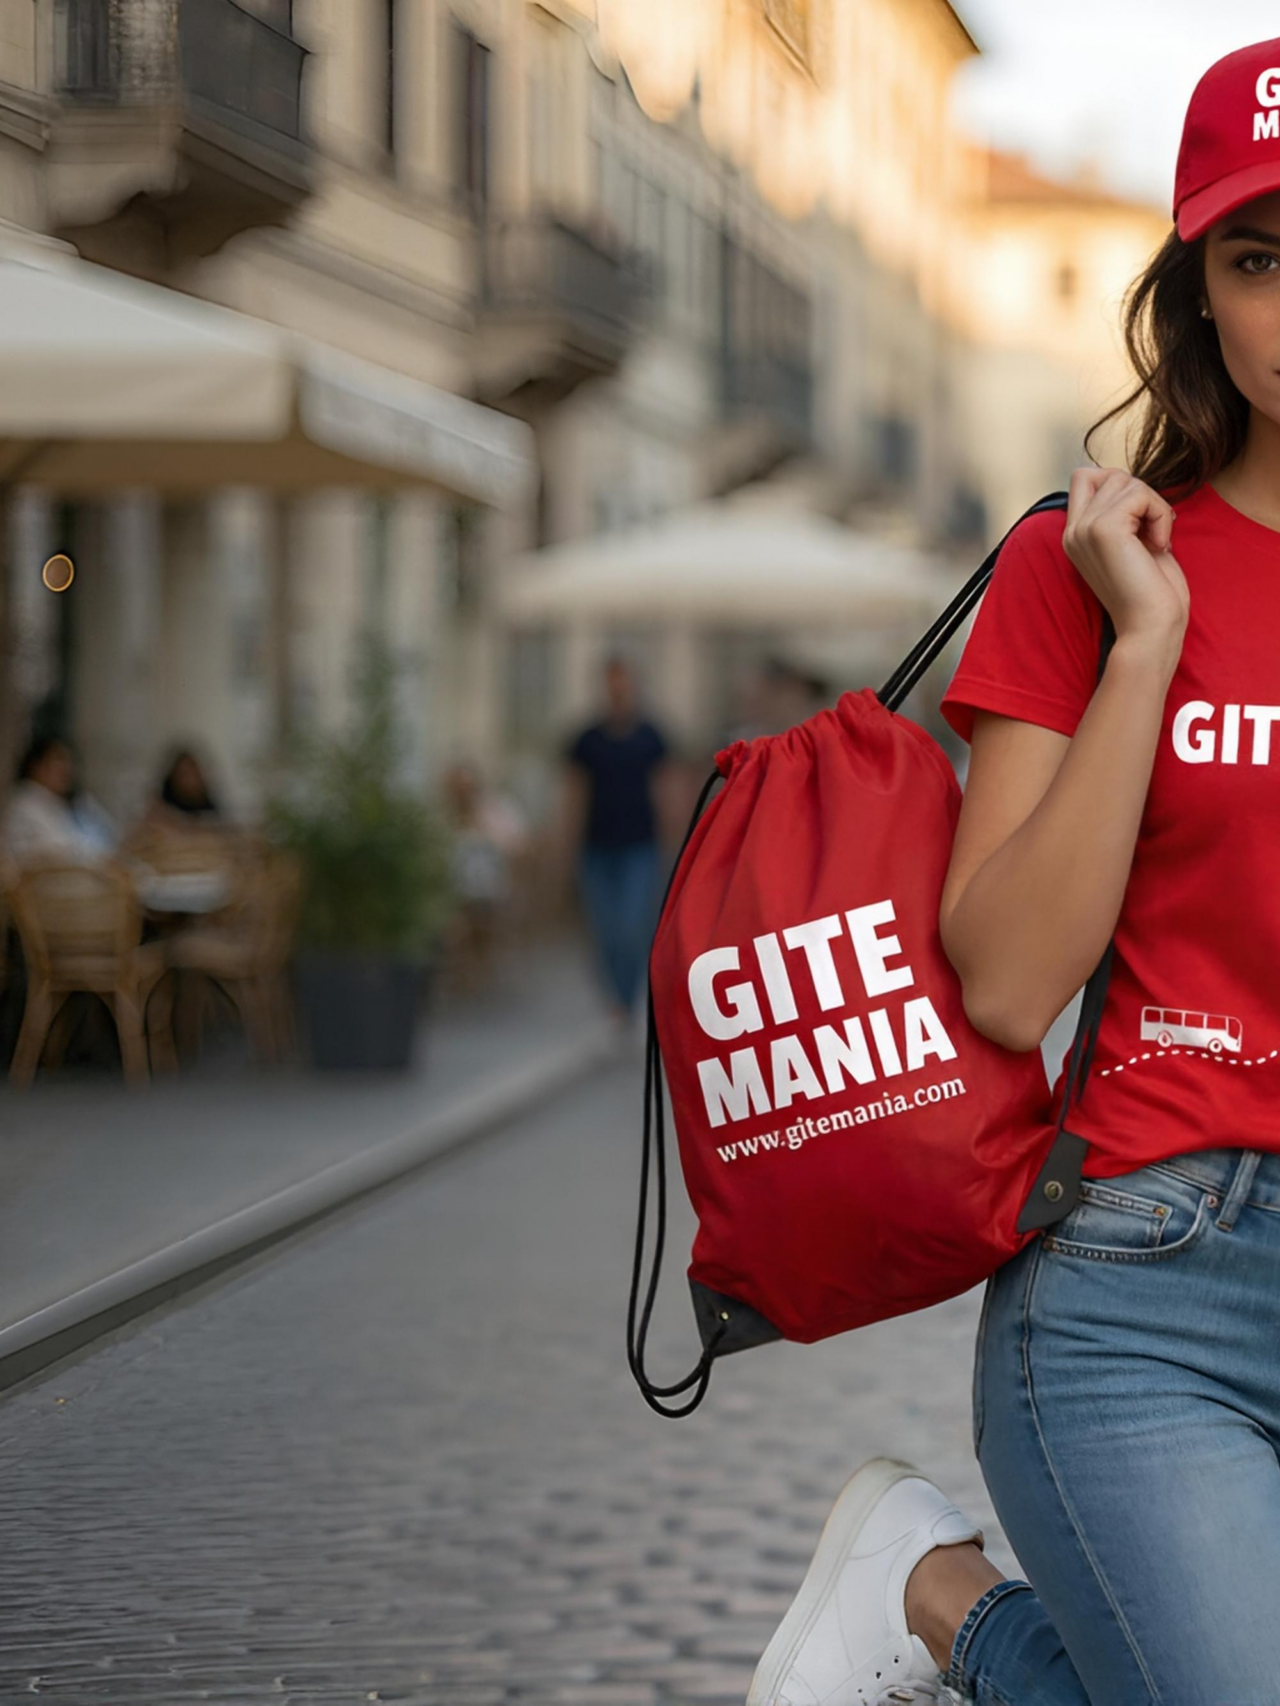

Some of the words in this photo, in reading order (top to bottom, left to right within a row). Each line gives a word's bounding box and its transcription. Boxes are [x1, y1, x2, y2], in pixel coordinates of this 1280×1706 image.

[687, 899, 915, 1041] GITE
[696, 995, 958, 1128] MANIA
[716, 1077, 967, 1164] www.gitemania.com
